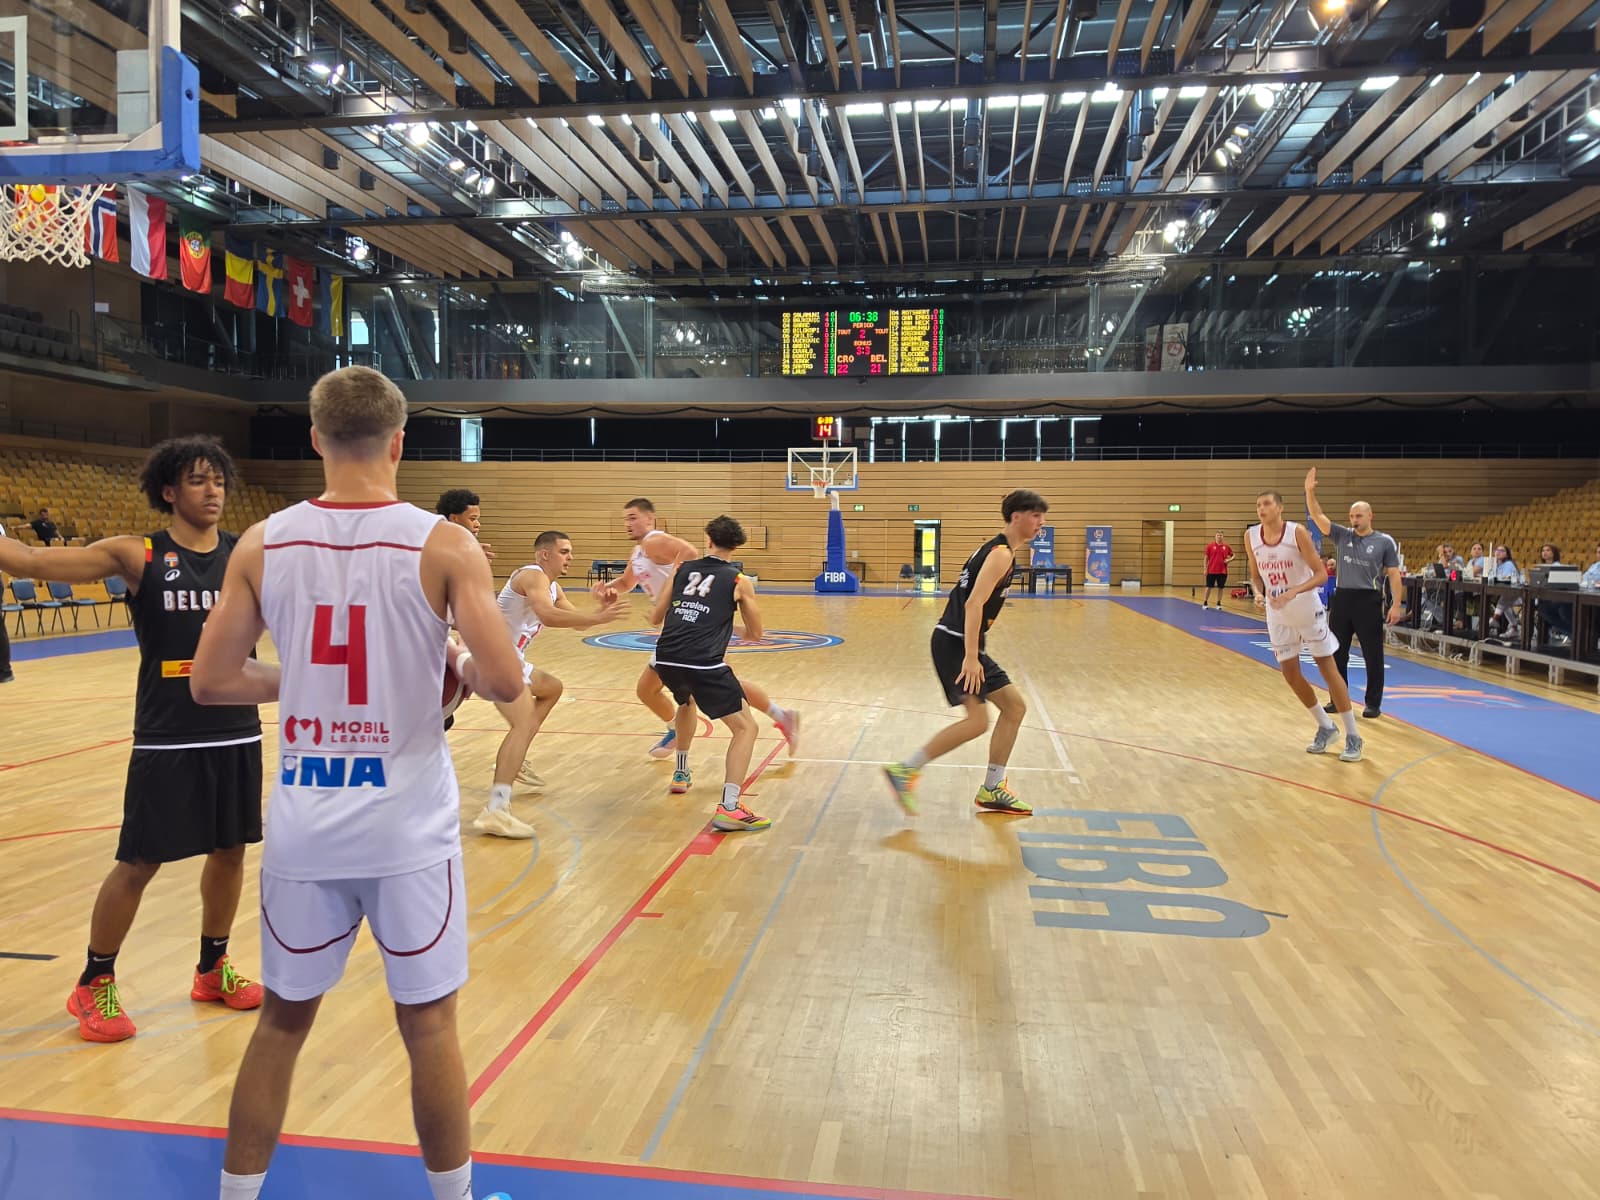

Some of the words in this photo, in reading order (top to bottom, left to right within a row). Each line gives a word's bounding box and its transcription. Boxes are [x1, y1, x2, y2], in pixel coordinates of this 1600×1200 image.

[848, 311, 879, 322] 06:38
[859, 329, 866, 339] 2
[836, 354, 855, 363] CRO
[870, 354, 888, 363] BEL
[837, 364, 848, 374] 22
[870, 363, 881, 374] 21
[819, 425, 832, 436] 14
[824, 572, 846, 584] FIBA
[1268, 572, 1289, 586] 24
[682, 571, 716, 598] 24
[674, 607, 701, 619] POWER
[680, 600, 711, 615] crelan
[310, 604, 368, 705] 4
[330, 721, 390, 734] MOBIL
[330, 734, 391, 744] LEASING
[1018, 808, 1272, 938] FIBA
